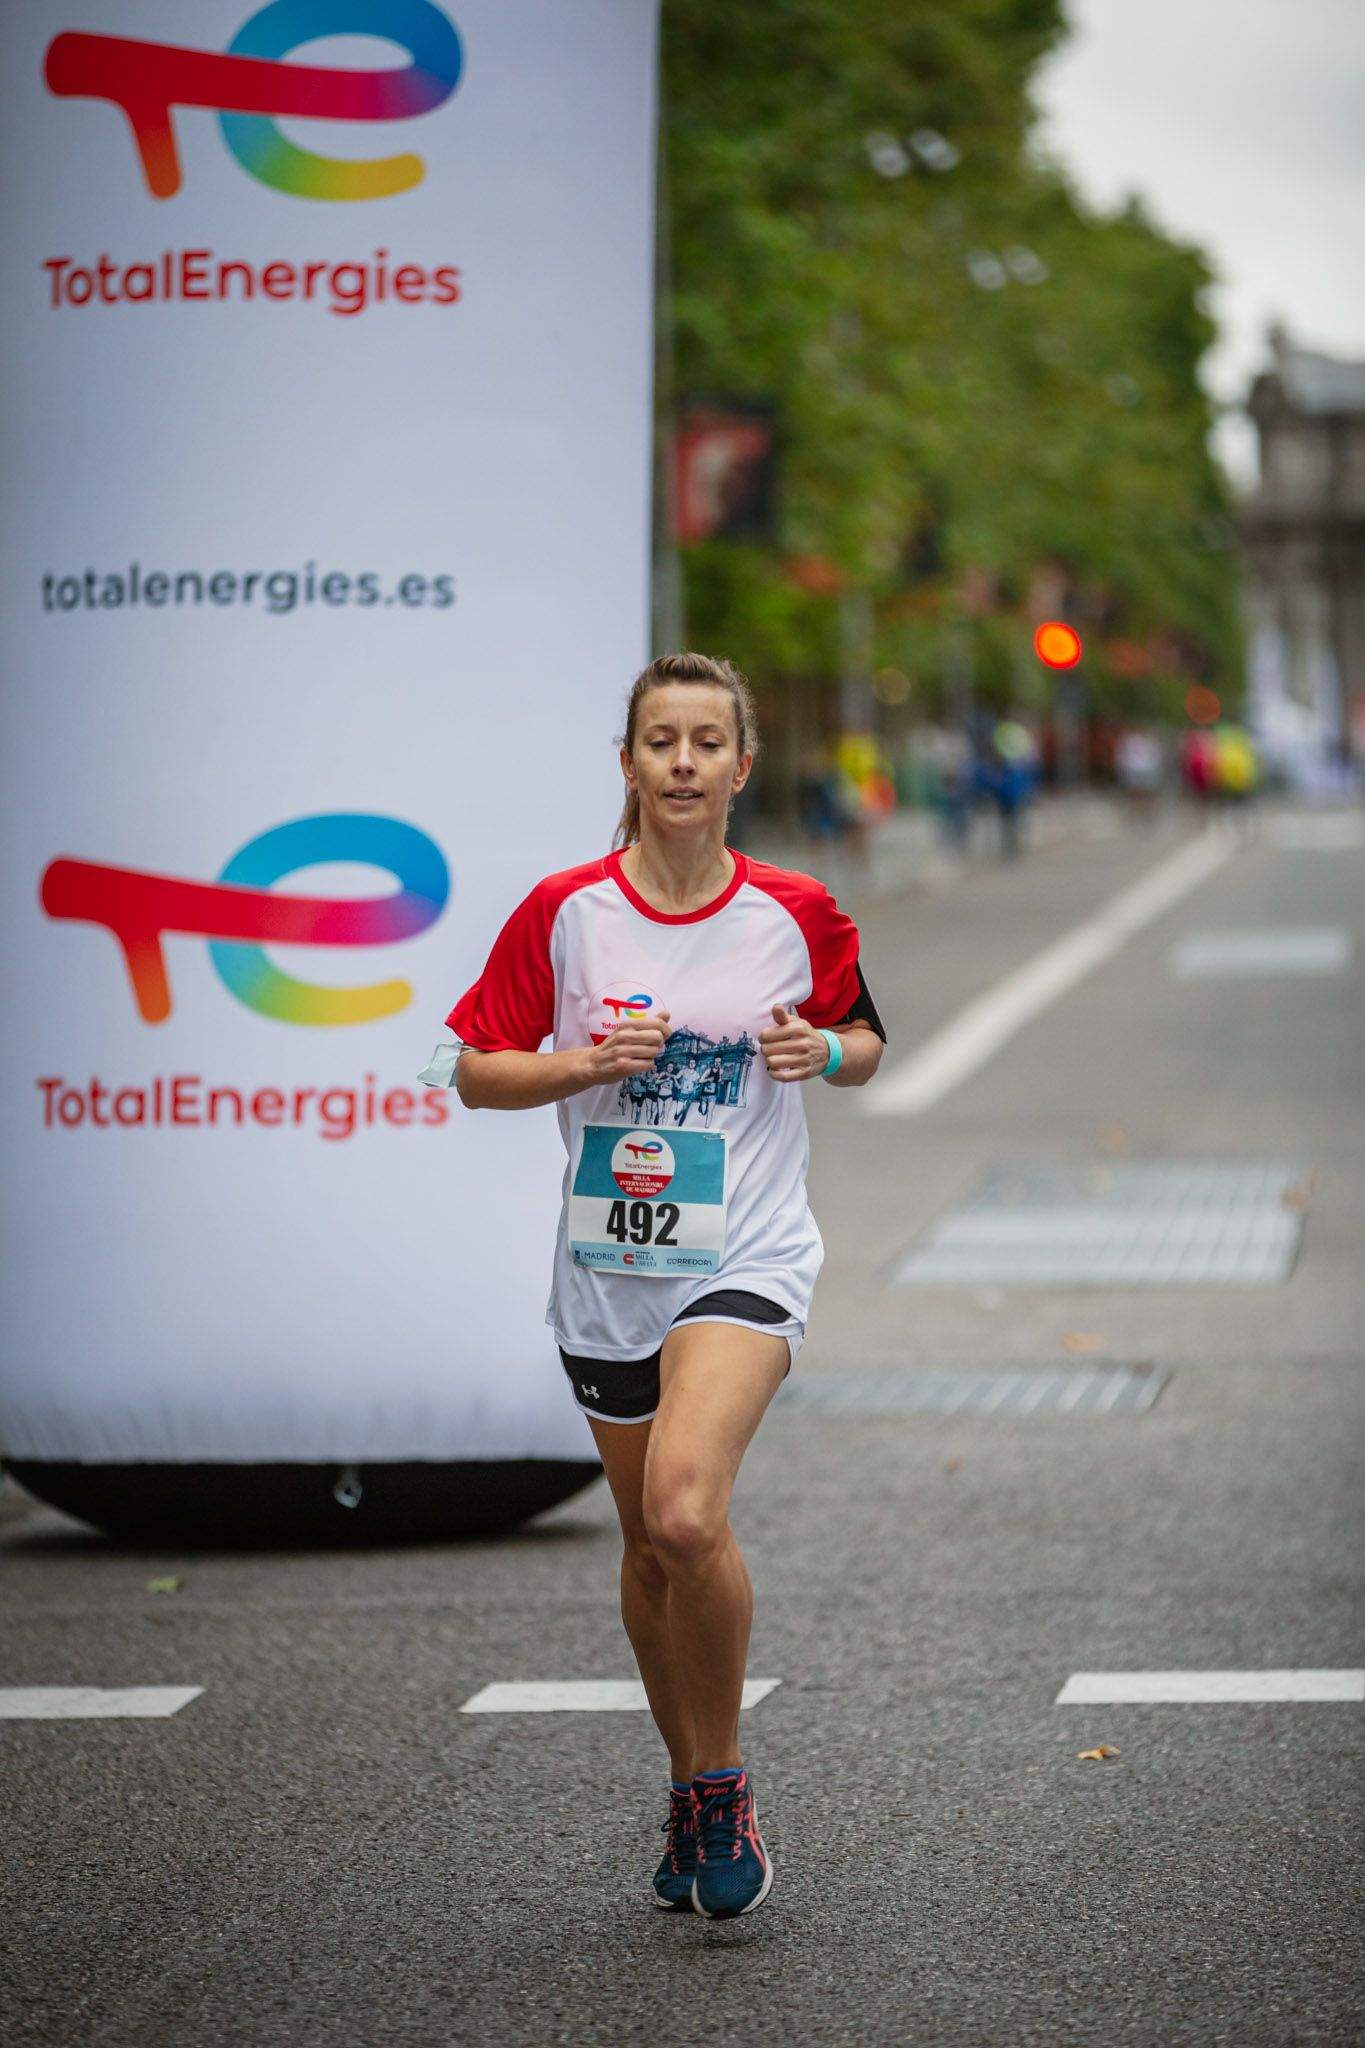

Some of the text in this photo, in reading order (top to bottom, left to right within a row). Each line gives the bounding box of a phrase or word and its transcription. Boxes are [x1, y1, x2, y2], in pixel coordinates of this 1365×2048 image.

[43, 247, 462, 318] TotalEnergies
[42, 561, 457, 614] totalenergies.es
[37, 1072, 450, 1142] TotalEnergies
[606, 1200, 680, 1247] 492
[584, 1251, 616, 1261] MADRID
